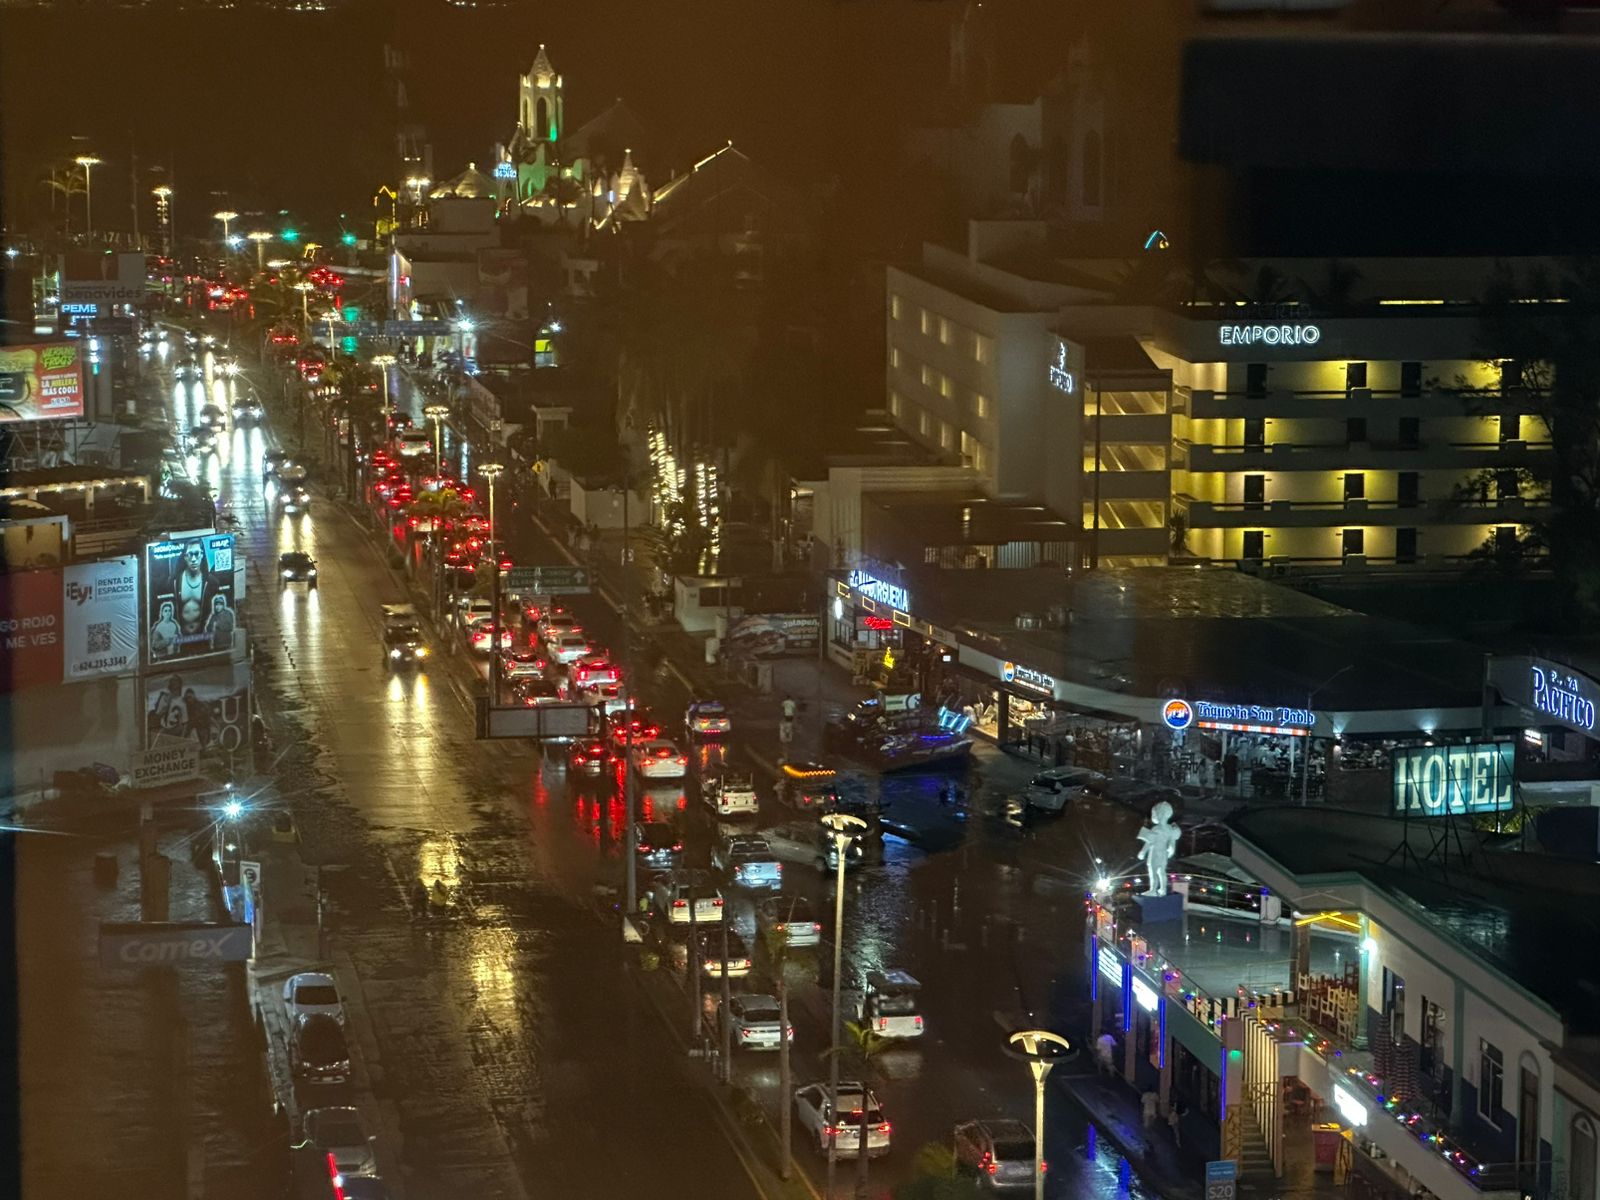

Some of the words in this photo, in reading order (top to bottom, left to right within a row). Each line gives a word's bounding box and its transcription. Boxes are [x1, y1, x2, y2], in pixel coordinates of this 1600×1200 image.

[1219, 325, 1320, 345] EMPORIO
[97, 578, 121, 586] RENTA
[123, 576, 134, 584] DE
[97, 584, 134, 596] ESPACIOS
[22, 614, 56, 629] ROJO
[6, 636, 26, 650] ME
[31, 632, 56, 646] VES
[1532, 666, 1595, 730] PACIFICO
[143, 748, 187, 764] MONEY
[135, 759, 196, 778] EXCHANGE
[1396, 751, 1511, 811] HOTEL
